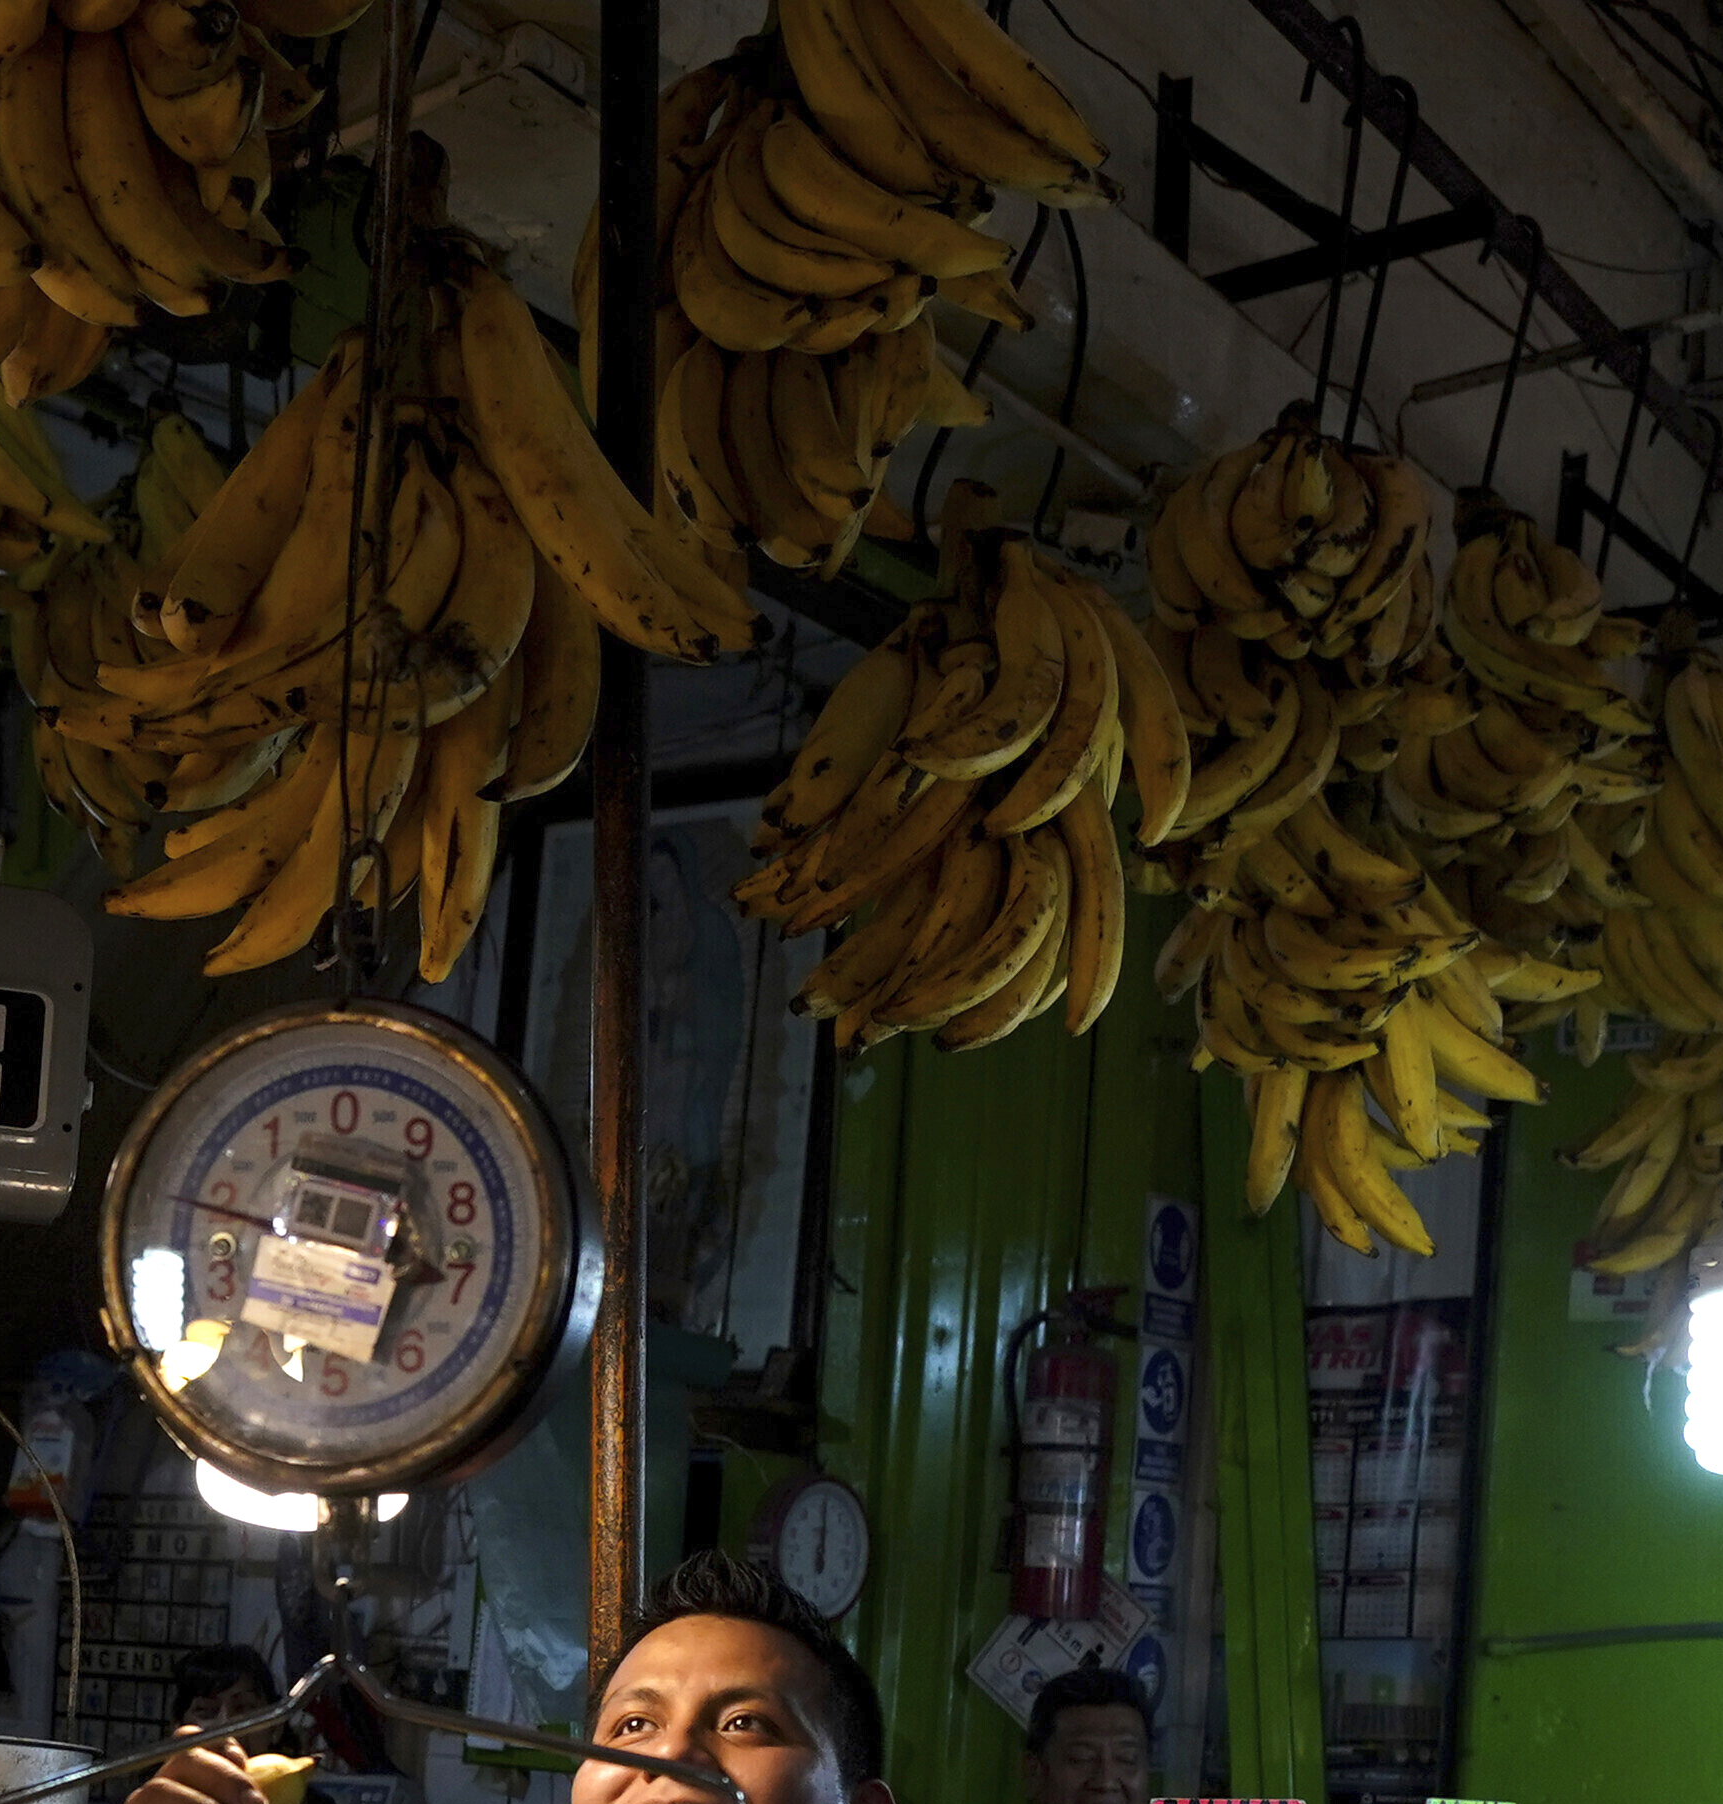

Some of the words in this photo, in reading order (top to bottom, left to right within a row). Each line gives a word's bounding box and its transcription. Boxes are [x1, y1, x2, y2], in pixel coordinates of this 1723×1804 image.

[330, 1091, 360, 1134] 0
[263, 1116, 283, 1158] 1
[404, 1117, 434, 1161] 9
[448, 1181, 476, 1225] 8
[207, 1260, 235, 1302] 3
[446, 1263, 476, 1305] 7
[393, 1329, 426, 1373] 6
[321, 1354, 350, 1396] 5
